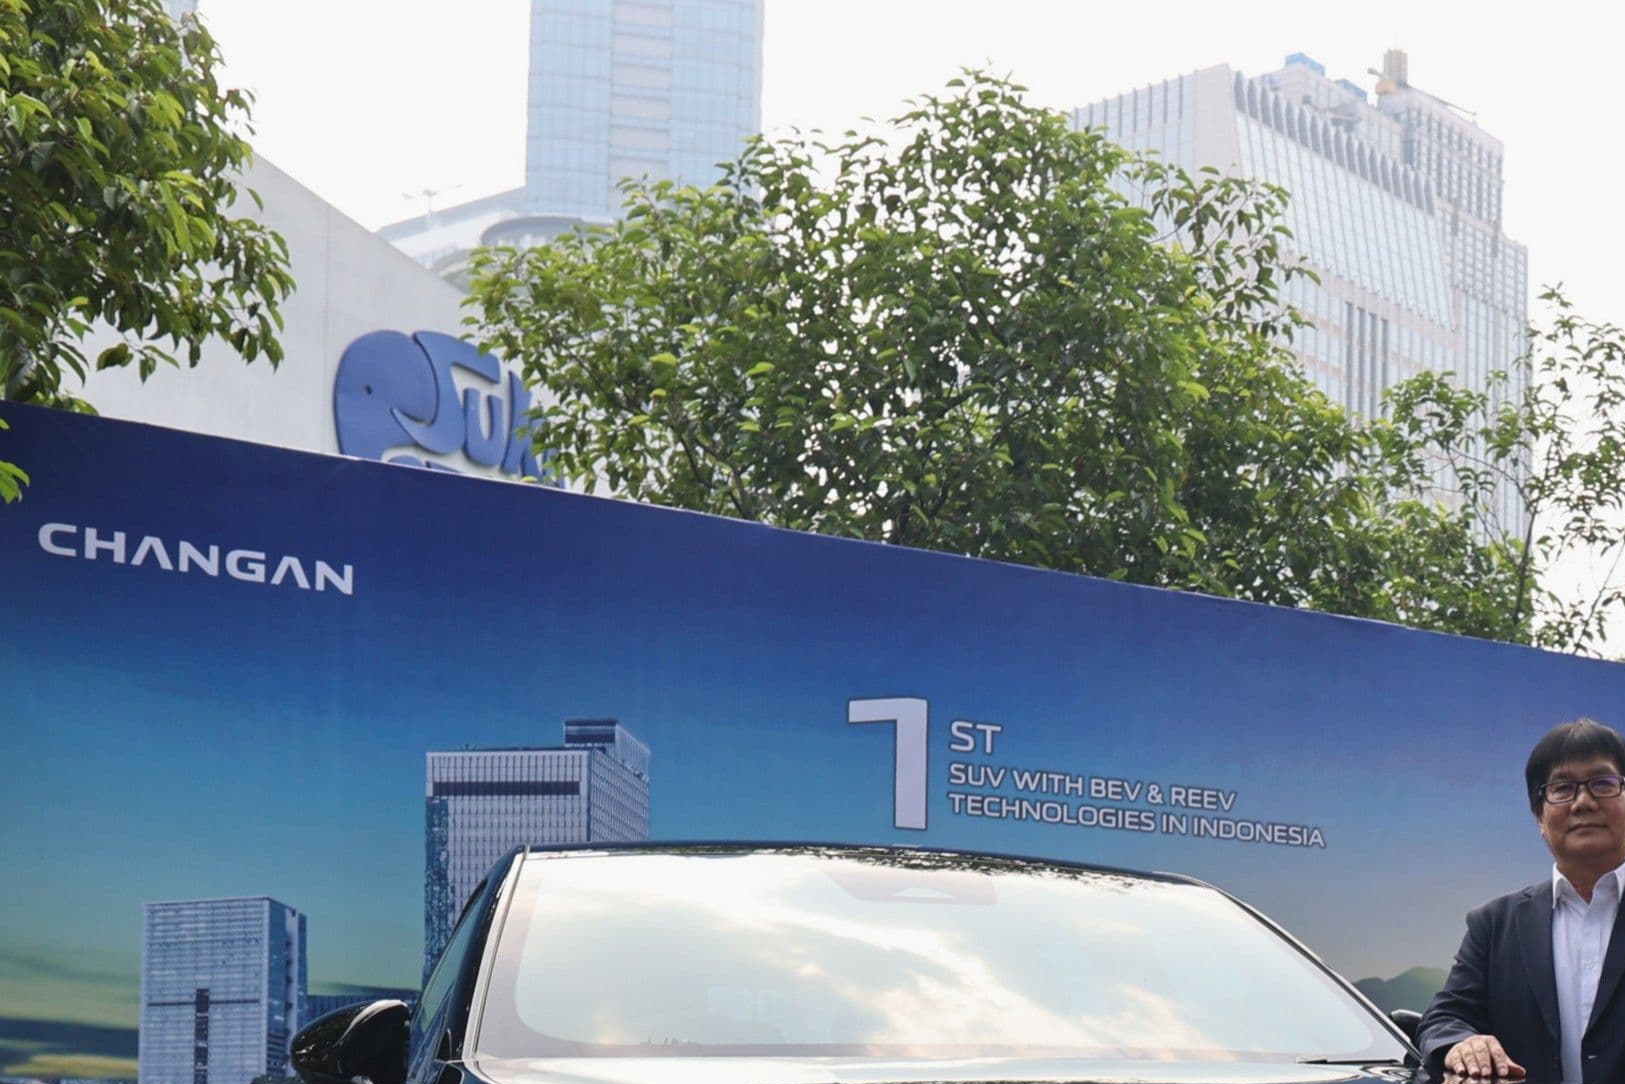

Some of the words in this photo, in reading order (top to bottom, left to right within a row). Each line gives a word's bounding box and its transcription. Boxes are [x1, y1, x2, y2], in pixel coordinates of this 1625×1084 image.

[38, 522, 353, 595] CHANGAN
[848, 697, 928, 830] 1
[949, 720, 1002, 754] ST
[949, 763, 1006, 787] SUV
[1013, 769, 1084, 797] WITH
[1090, 777, 1142, 804] BEV
[1147, 783, 1164, 805] &
[1171, 787, 1237, 811] REEV
[949, 792, 1155, 833] TECHNOLOGIES
[1162, 814, 1188, 835] IN
[1193, 816, 1327, 848] INDONESIA
